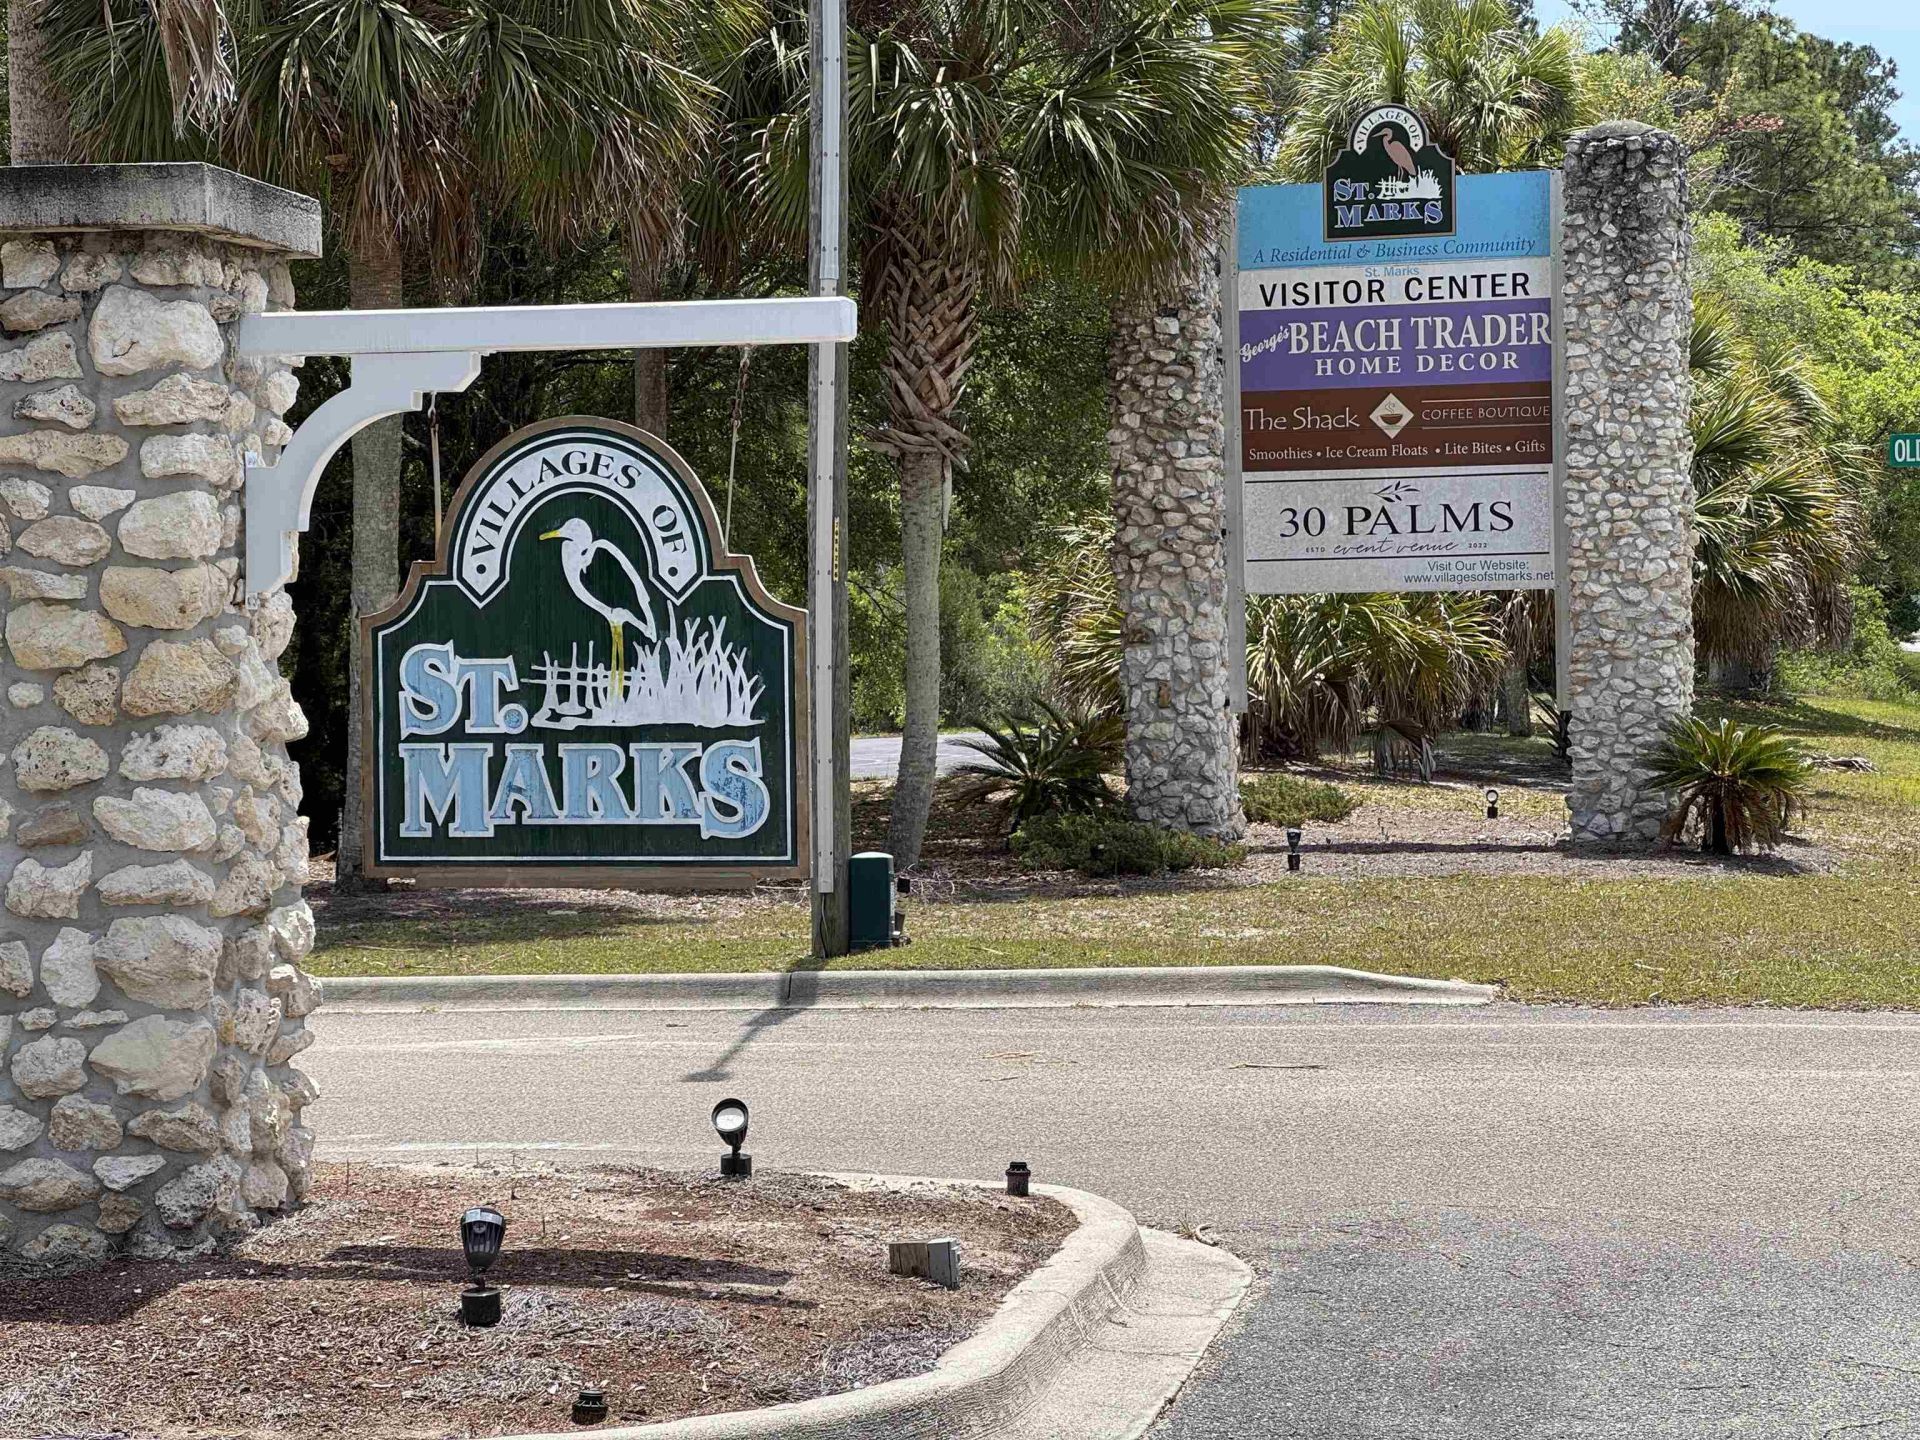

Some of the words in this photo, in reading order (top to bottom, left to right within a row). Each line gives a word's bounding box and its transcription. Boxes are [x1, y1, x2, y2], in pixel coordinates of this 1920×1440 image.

[1357, 110, 1410, 144] VILLAGES
[1408, 125, 1421, 141] OF
[1333, 177, 1375, 201] ST.
[1334, 200, 1443, 229] MARKS
[1253, 250, 1265, 263] A
[1270, 246, 1351, 263] Residential
[1356, 247, 1370, 259] &
[1375, 242, 1438, 260] Business
[1443, 237, 1536, 257] Community
[1364, 267, 1381, 278] St.
[1384, 265, 1420, 277] Marks
[1259, 279, 1386, 308] VISITOR
[1404, 272, 1531, 302] CENTER
[1239, 325, 1289, 363] George's
[1288, 317, 1402, 354] BEACH
[1410, 312, 1552, 349] TRADER
[1315, 355, 1401, 376] HOME
[1416, 351, 1519, 373] DECOR
[1244, 408, 1287, 431] The
[1292, 407, 1361, 431] Shack
[1422, 407, 1474, 421] COFFEE
[1478, 405, 1550, 419] BOUTIQUE
[1249, 446, 1313, 461] Smoothies
[1325, 446, 1344, 459] Ice
[1347, 445, 1388, 458] Cream
[1391, 444, 1429, 457] Floats
[1445, 442, 1469, 455] Lite
[1472, 441, 1502, 454] Bites
[1515, 439, 1546, 453] Gifts
[471, 450, 642, 557] VILLAGES
[652, 504, 688, 557] OF
[1279, 506, 1327, 538] 30
[1342, 501, 1514, 536] PALMS
[1333, 536, 1394, 554] event
[1396, 541, 1459, 555] venue
[1404, 571, 1555, 585] www.villagesofstmarks.net
[1427, 561, 1452, 572] Visit
[1455, 560, 1477, 572] Our
[1479, 560, 1529, 571] Website:
[399, 640, 528, 739] ST.
[399, 737, 771, 839] MARKS
